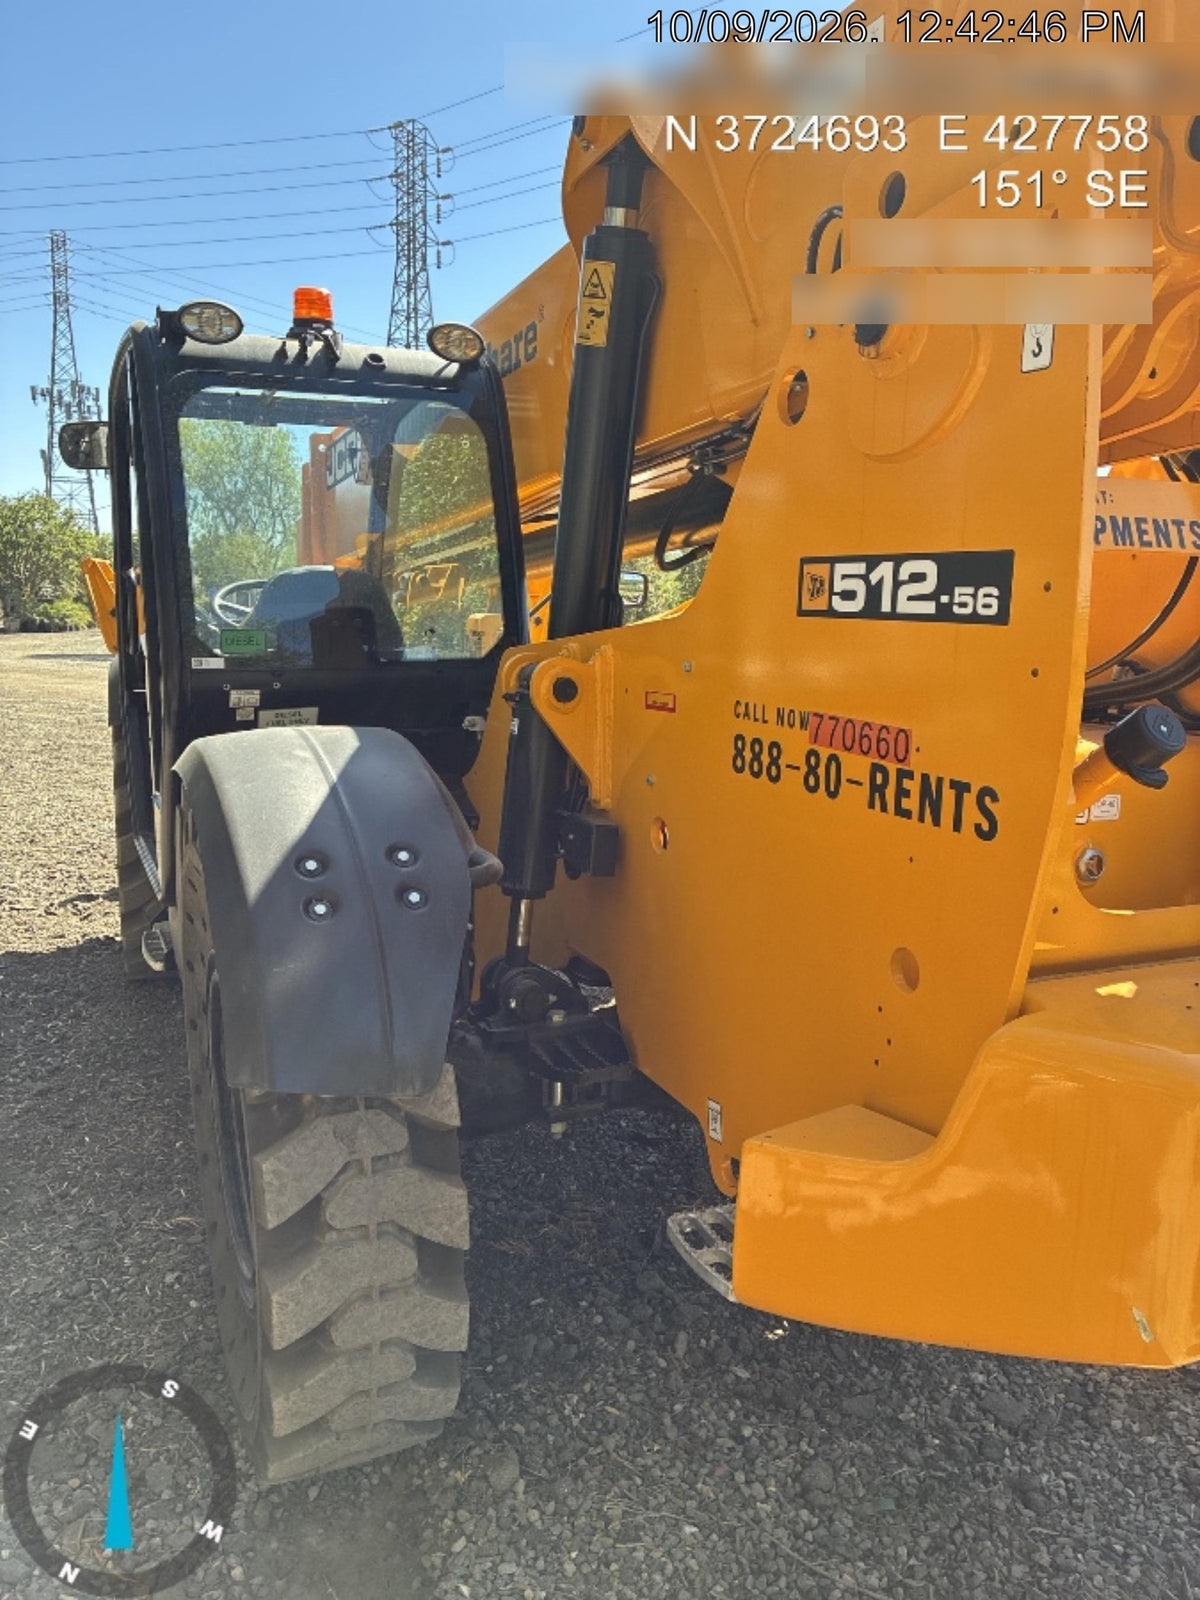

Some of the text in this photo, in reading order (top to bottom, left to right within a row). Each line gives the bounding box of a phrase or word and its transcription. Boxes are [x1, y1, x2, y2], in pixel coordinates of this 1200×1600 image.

[733, 700, 810, 732] CALL NOW
[812, 712, 911, 764] 770660
[732, 734, 1000, 841] 888-80-RENTS
